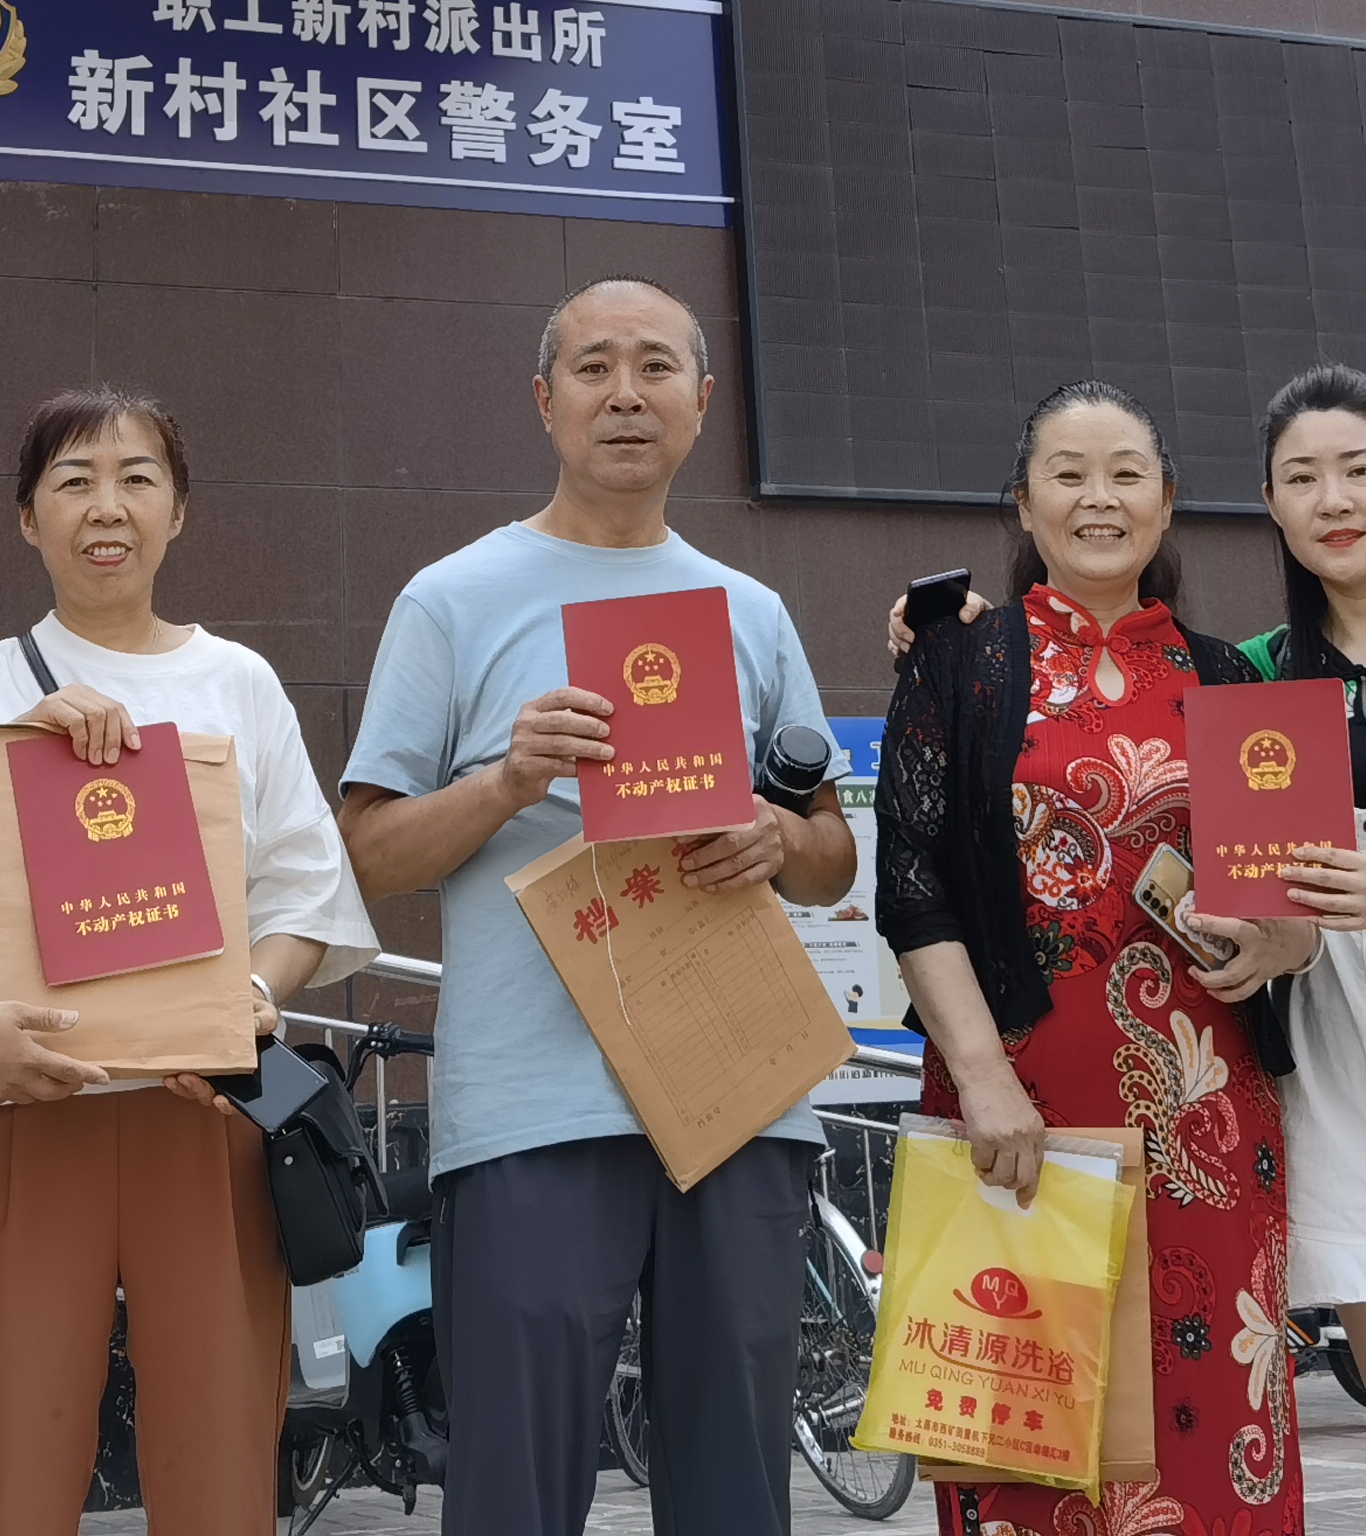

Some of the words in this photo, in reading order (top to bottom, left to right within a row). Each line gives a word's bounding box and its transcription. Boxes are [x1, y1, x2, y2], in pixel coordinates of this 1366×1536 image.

[66, 49, 687, 176] 新村社区警务室
[603, 752, 723, 777] 中华人民共和国
[615, 773, 716, 799] 不动产权证书
[60, 881, 187, 916] 中华人民共和国
[74, 903, 180, 937] 不动产权证书
[902, 1315, 1075, 1384] 沐清源洗浴
[898, 1358, 927, 1375] MU
[929, 1364, 974, 1386] QING
[978, 1374, 1029, 1398] YUAN
[1031, 1385, 1050, 1402] XI
[1053, 1390, 1076, 1410] YU
[924, 1388, 1044, 1432] 免费停车
